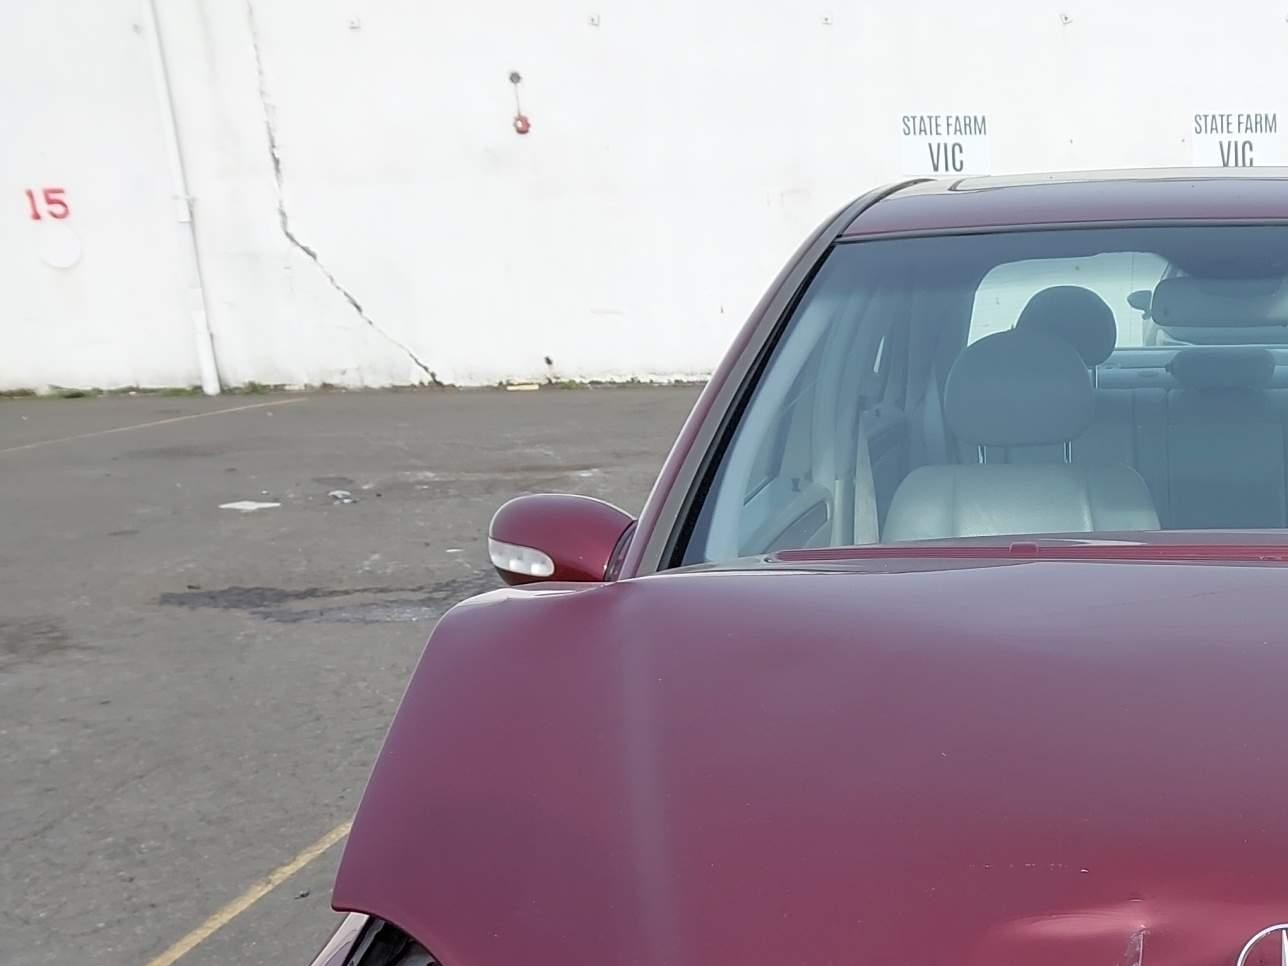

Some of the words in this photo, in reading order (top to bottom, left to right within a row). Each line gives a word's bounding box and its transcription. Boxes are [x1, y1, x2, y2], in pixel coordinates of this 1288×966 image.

[902, 115, 942, 136] STATE
[946, 115, 987, 136] FARM
[1194, 113, 1233, 135] STATE
[1237, 113, 1277, 135] FARM
[927, 142, 964, 173] VIC
[1219, 140, 1254, 167] VIC
[26, 188, 70, 220] 15
